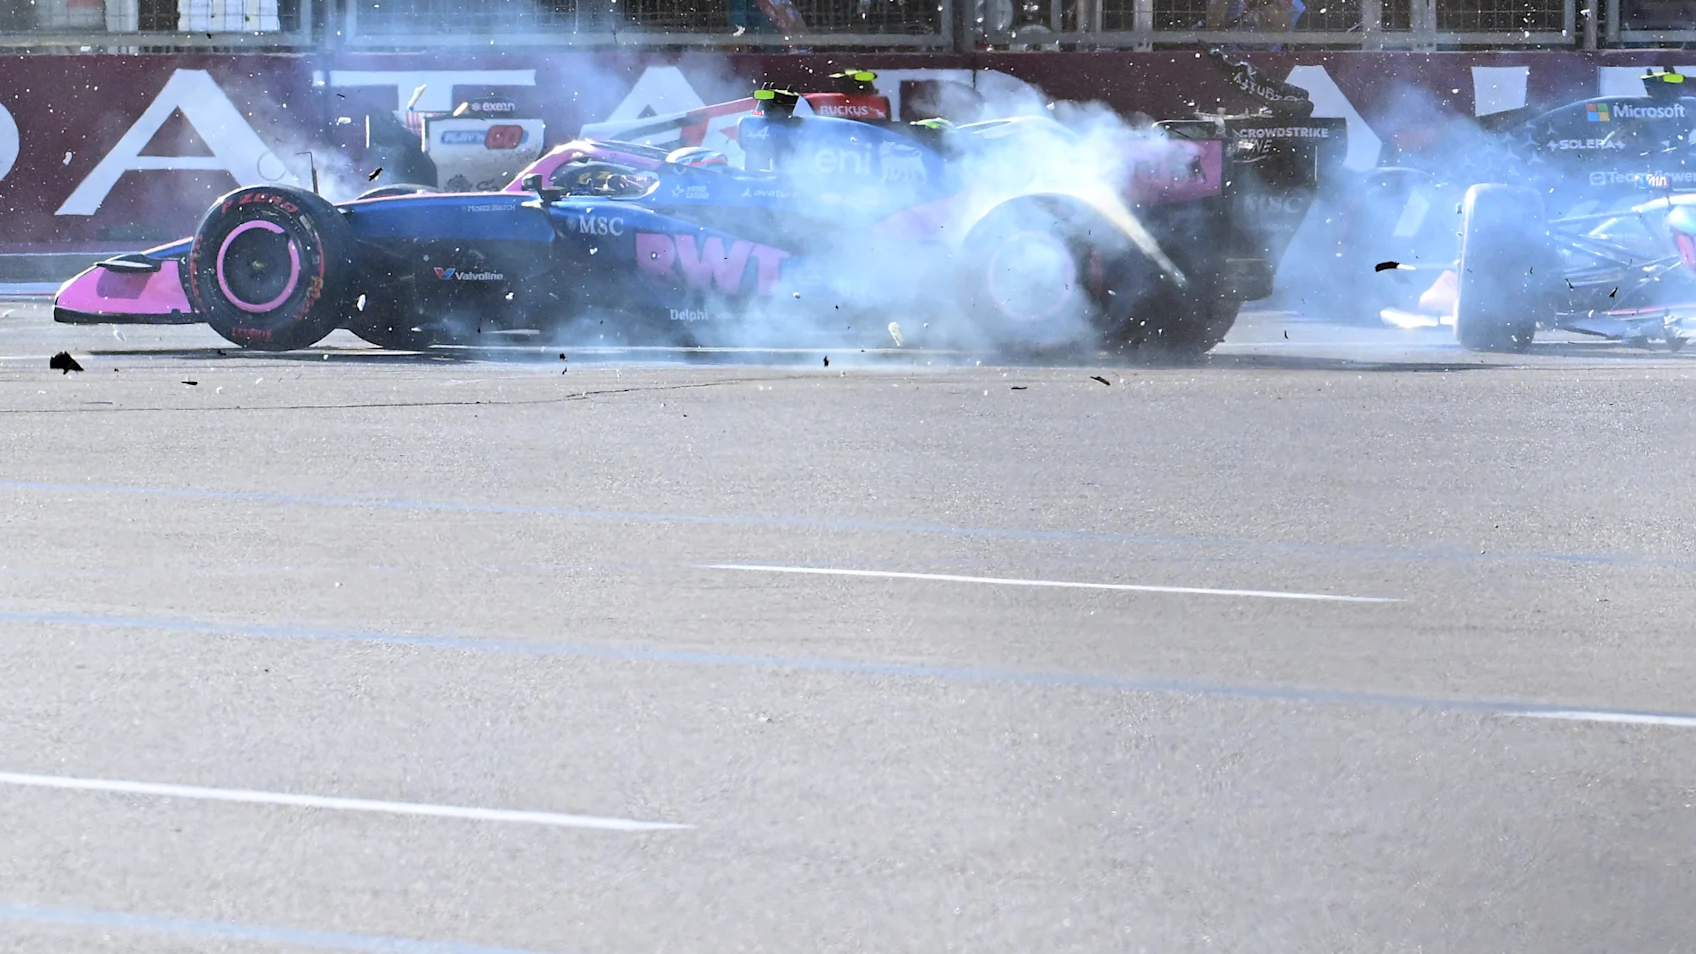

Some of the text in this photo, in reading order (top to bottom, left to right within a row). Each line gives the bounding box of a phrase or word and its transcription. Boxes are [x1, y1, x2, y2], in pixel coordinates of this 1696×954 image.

[820, 105, 868, 116] RUCKUS
[1613, 104, 1686, 119] Microsoft
[1240, 127, 1329, 139] CROWDSTRIKE
[1560, 139, 1616, 150] SOLERA
[813, 147, 872, 174] eni
[579, 215, 625, 236] MSC
[455, 271, 504, 281] Valvoline
[669, 309, 709, 321] Delphi
